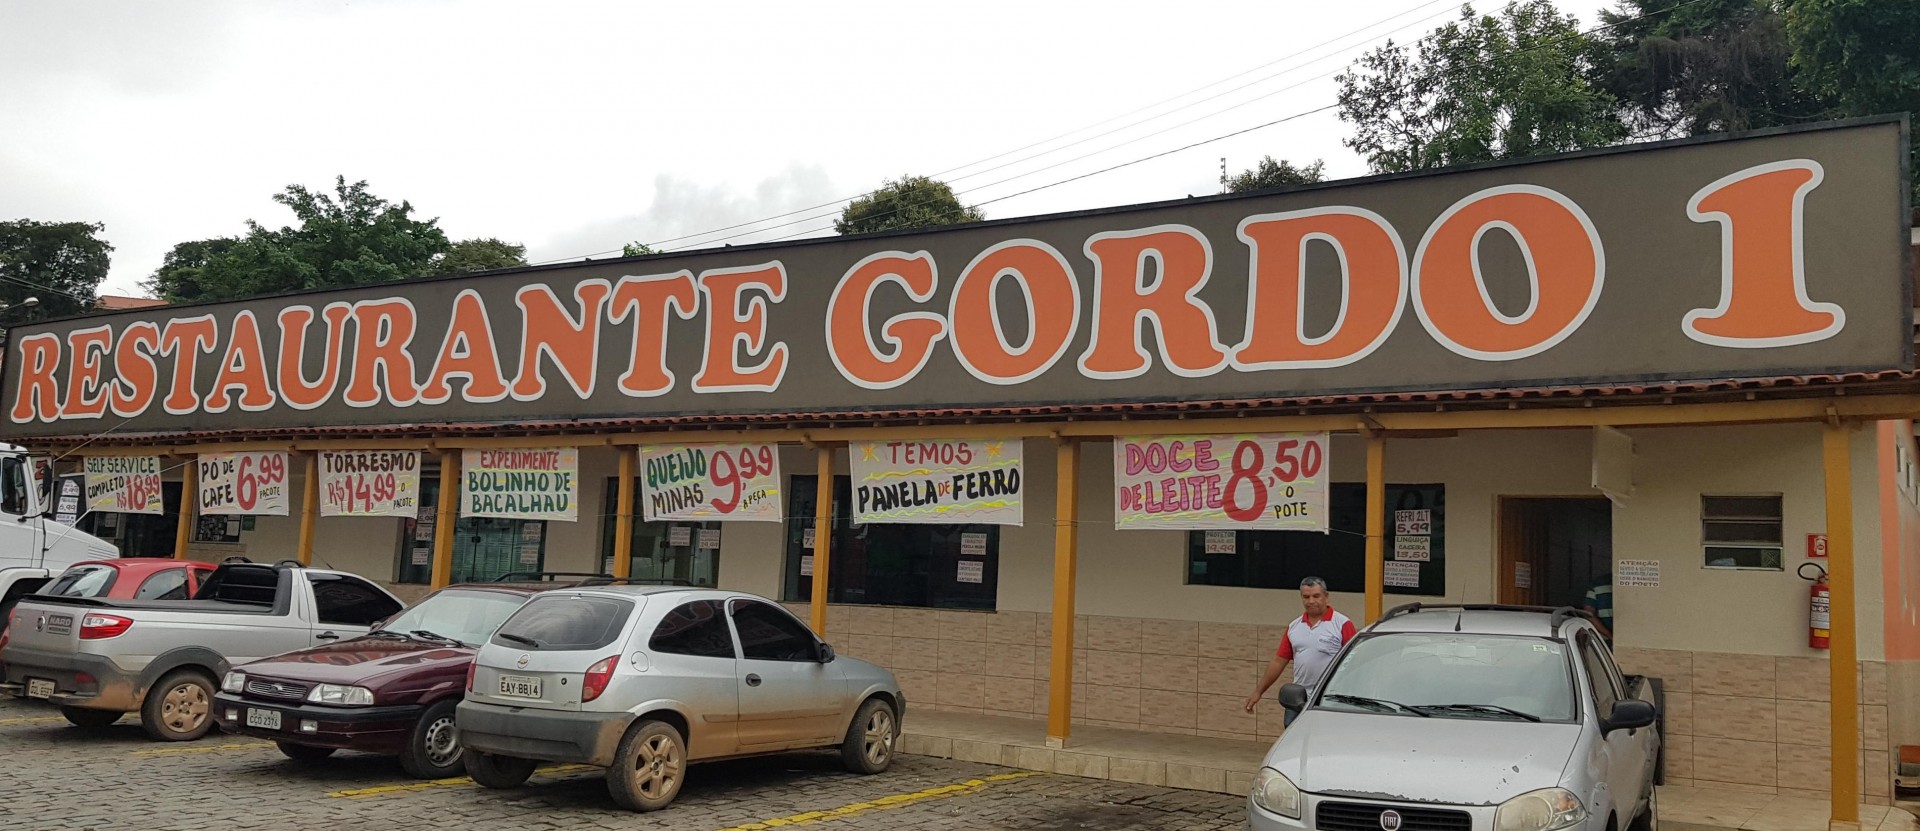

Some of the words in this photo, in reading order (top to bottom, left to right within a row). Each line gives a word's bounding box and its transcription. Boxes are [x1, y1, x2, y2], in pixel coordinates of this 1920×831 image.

[9, 259, 788, 425] RESTAURANTE
[825, 184, 1605, 389] GORDO
[1681, 159, 1846, 348] 1
[324, 452, 416, 473] TORRESMO
[480, 451, 559, 470] EXPERIMENTE
[887, 442, 973, 465] TEMOS
[1125, 440, 1220, 475] DOCE
[87, 458, 106, 472] SELF
[107, 457, 155, 473] SERVICE
[88, 476, 124, 499] COMPLETO
[201, 458, 219, 482] PÓ
[223, 460, 235, 475] DE
[237, 453, 284, 510] 6,99
[468, 471, 549, 492] BOLINHO
[555, 472, 571, 492] DE
[646, 448, 707, 490] QUEIJO
[710, 445, 773, 514] 9,99
[1120, 484, 1142, 511] DE
[1144, 474, 1224, 513] LEITE
[1222, 440, 1322, 522] 8,50
[203, 480, 234, 508] CAFÉ
[259, 486, 280, 499] PACOTE
[651, 483, 704, 517] MINAS
[743, 498, 748, 510] A
[748, 489, 767, 505] PEÇA
[858, 480, 938, 513] PANELA
[938, 480, 950, 497] DE
[952, 468, 1020, 500] FERRO
[1285, 486, 1294, 498] O
[393, 498, 412, 509] PACOTE
[472, 494, 569, 513] BACALHAU
[1274, 502, 1307, 519] POTE
[1396, 510, 1415, 522] REFRI
[1416, 510, 1429, 522] 2LT
[1397, 523, 1429, 534] 5.99
[1396, 536, 1429, 544] LINGUIÇA
[1385, 816, 1397, 827] FIAT
